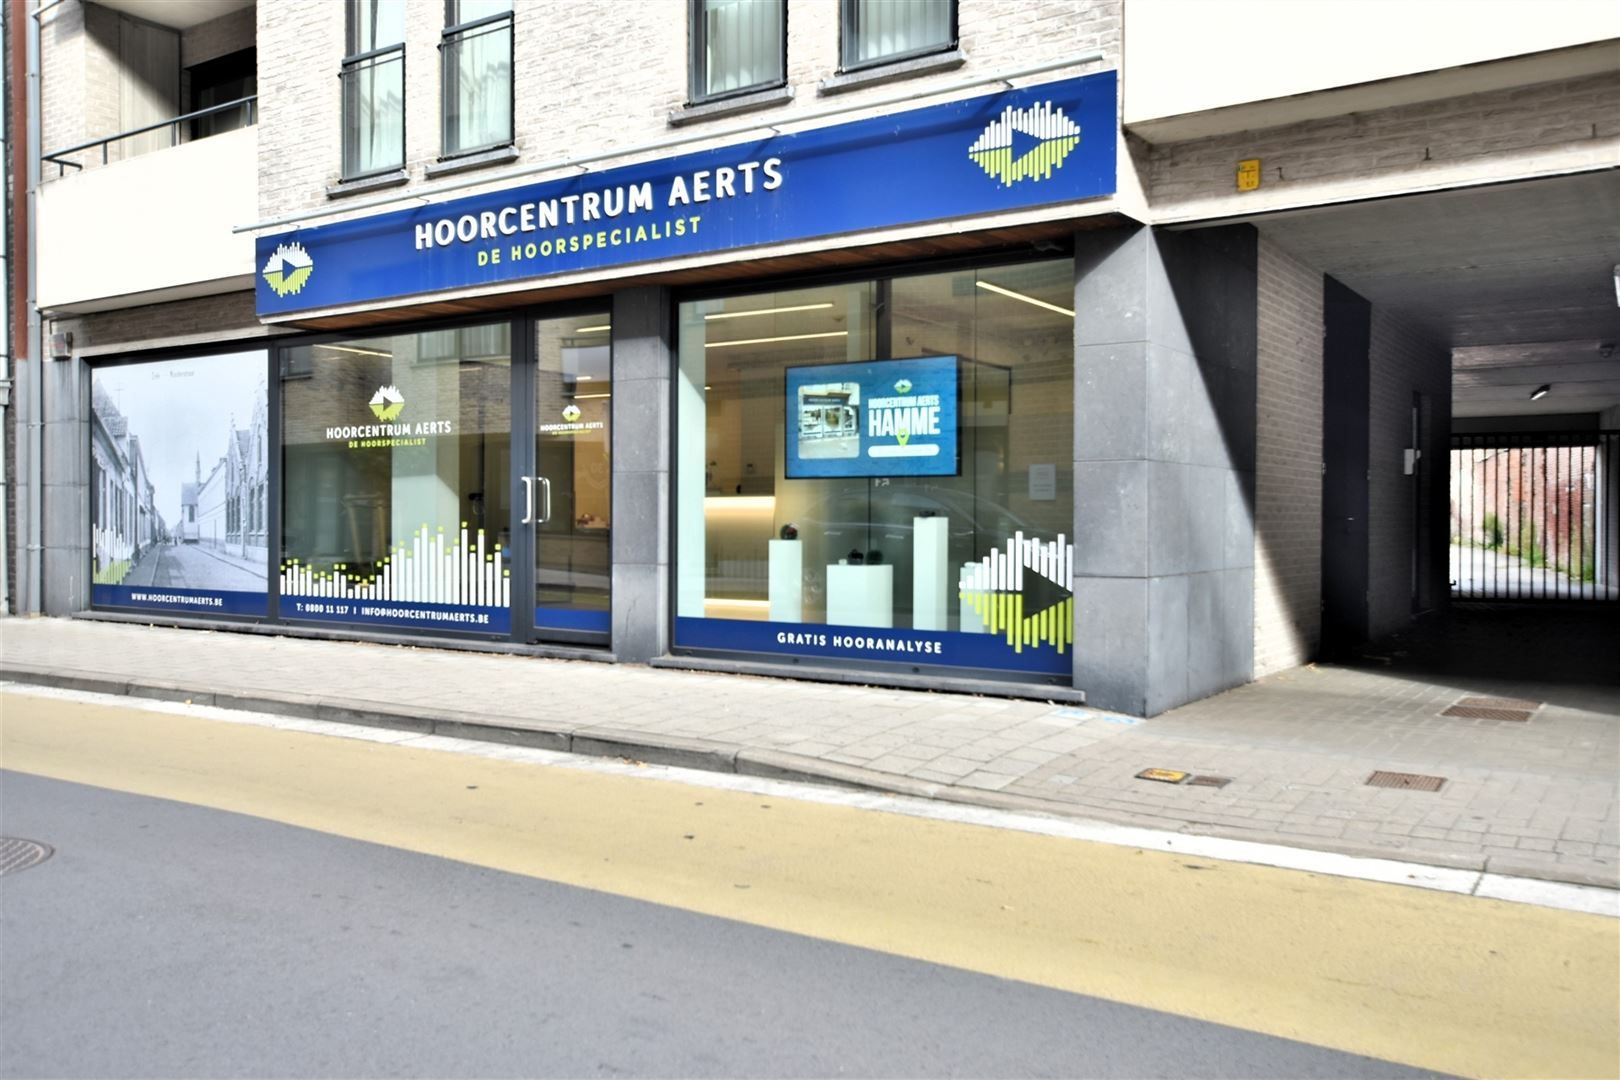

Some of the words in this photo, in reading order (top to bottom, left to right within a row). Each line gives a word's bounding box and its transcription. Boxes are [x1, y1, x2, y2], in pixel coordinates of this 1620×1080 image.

[414, 181, 654, 251] HOORCENTRUM
[668, 157, 784, 207] AERTS
[477, 248, 501, 267] DE
[511, 216, 702, 261] HOORSPECIALIST
[326, 423, 411, 439] HOORCENTRUM
[415, 420, 452, 435] AERTS
[868, 406, 941, 437] HAMME
[348, 440, 358, 448] DE
[361, 437, 427, 448] HOORSPECIALIST
[131, 592, 223, 607] WWW.HOORCENTRUMAERTS.BE
[296, 603, 304, 612] T:
[305, 603, 324, 613] 0800
[326, 605, 335, 614] 11
[336, 605, 349, 615] 117
[361, 606, 490, 624] INFO@HOORCENTRUMAERTS.BE
[777, 631, 827, 647] GRATIS
[833, 635, 942, 654] HOORANALYSE
